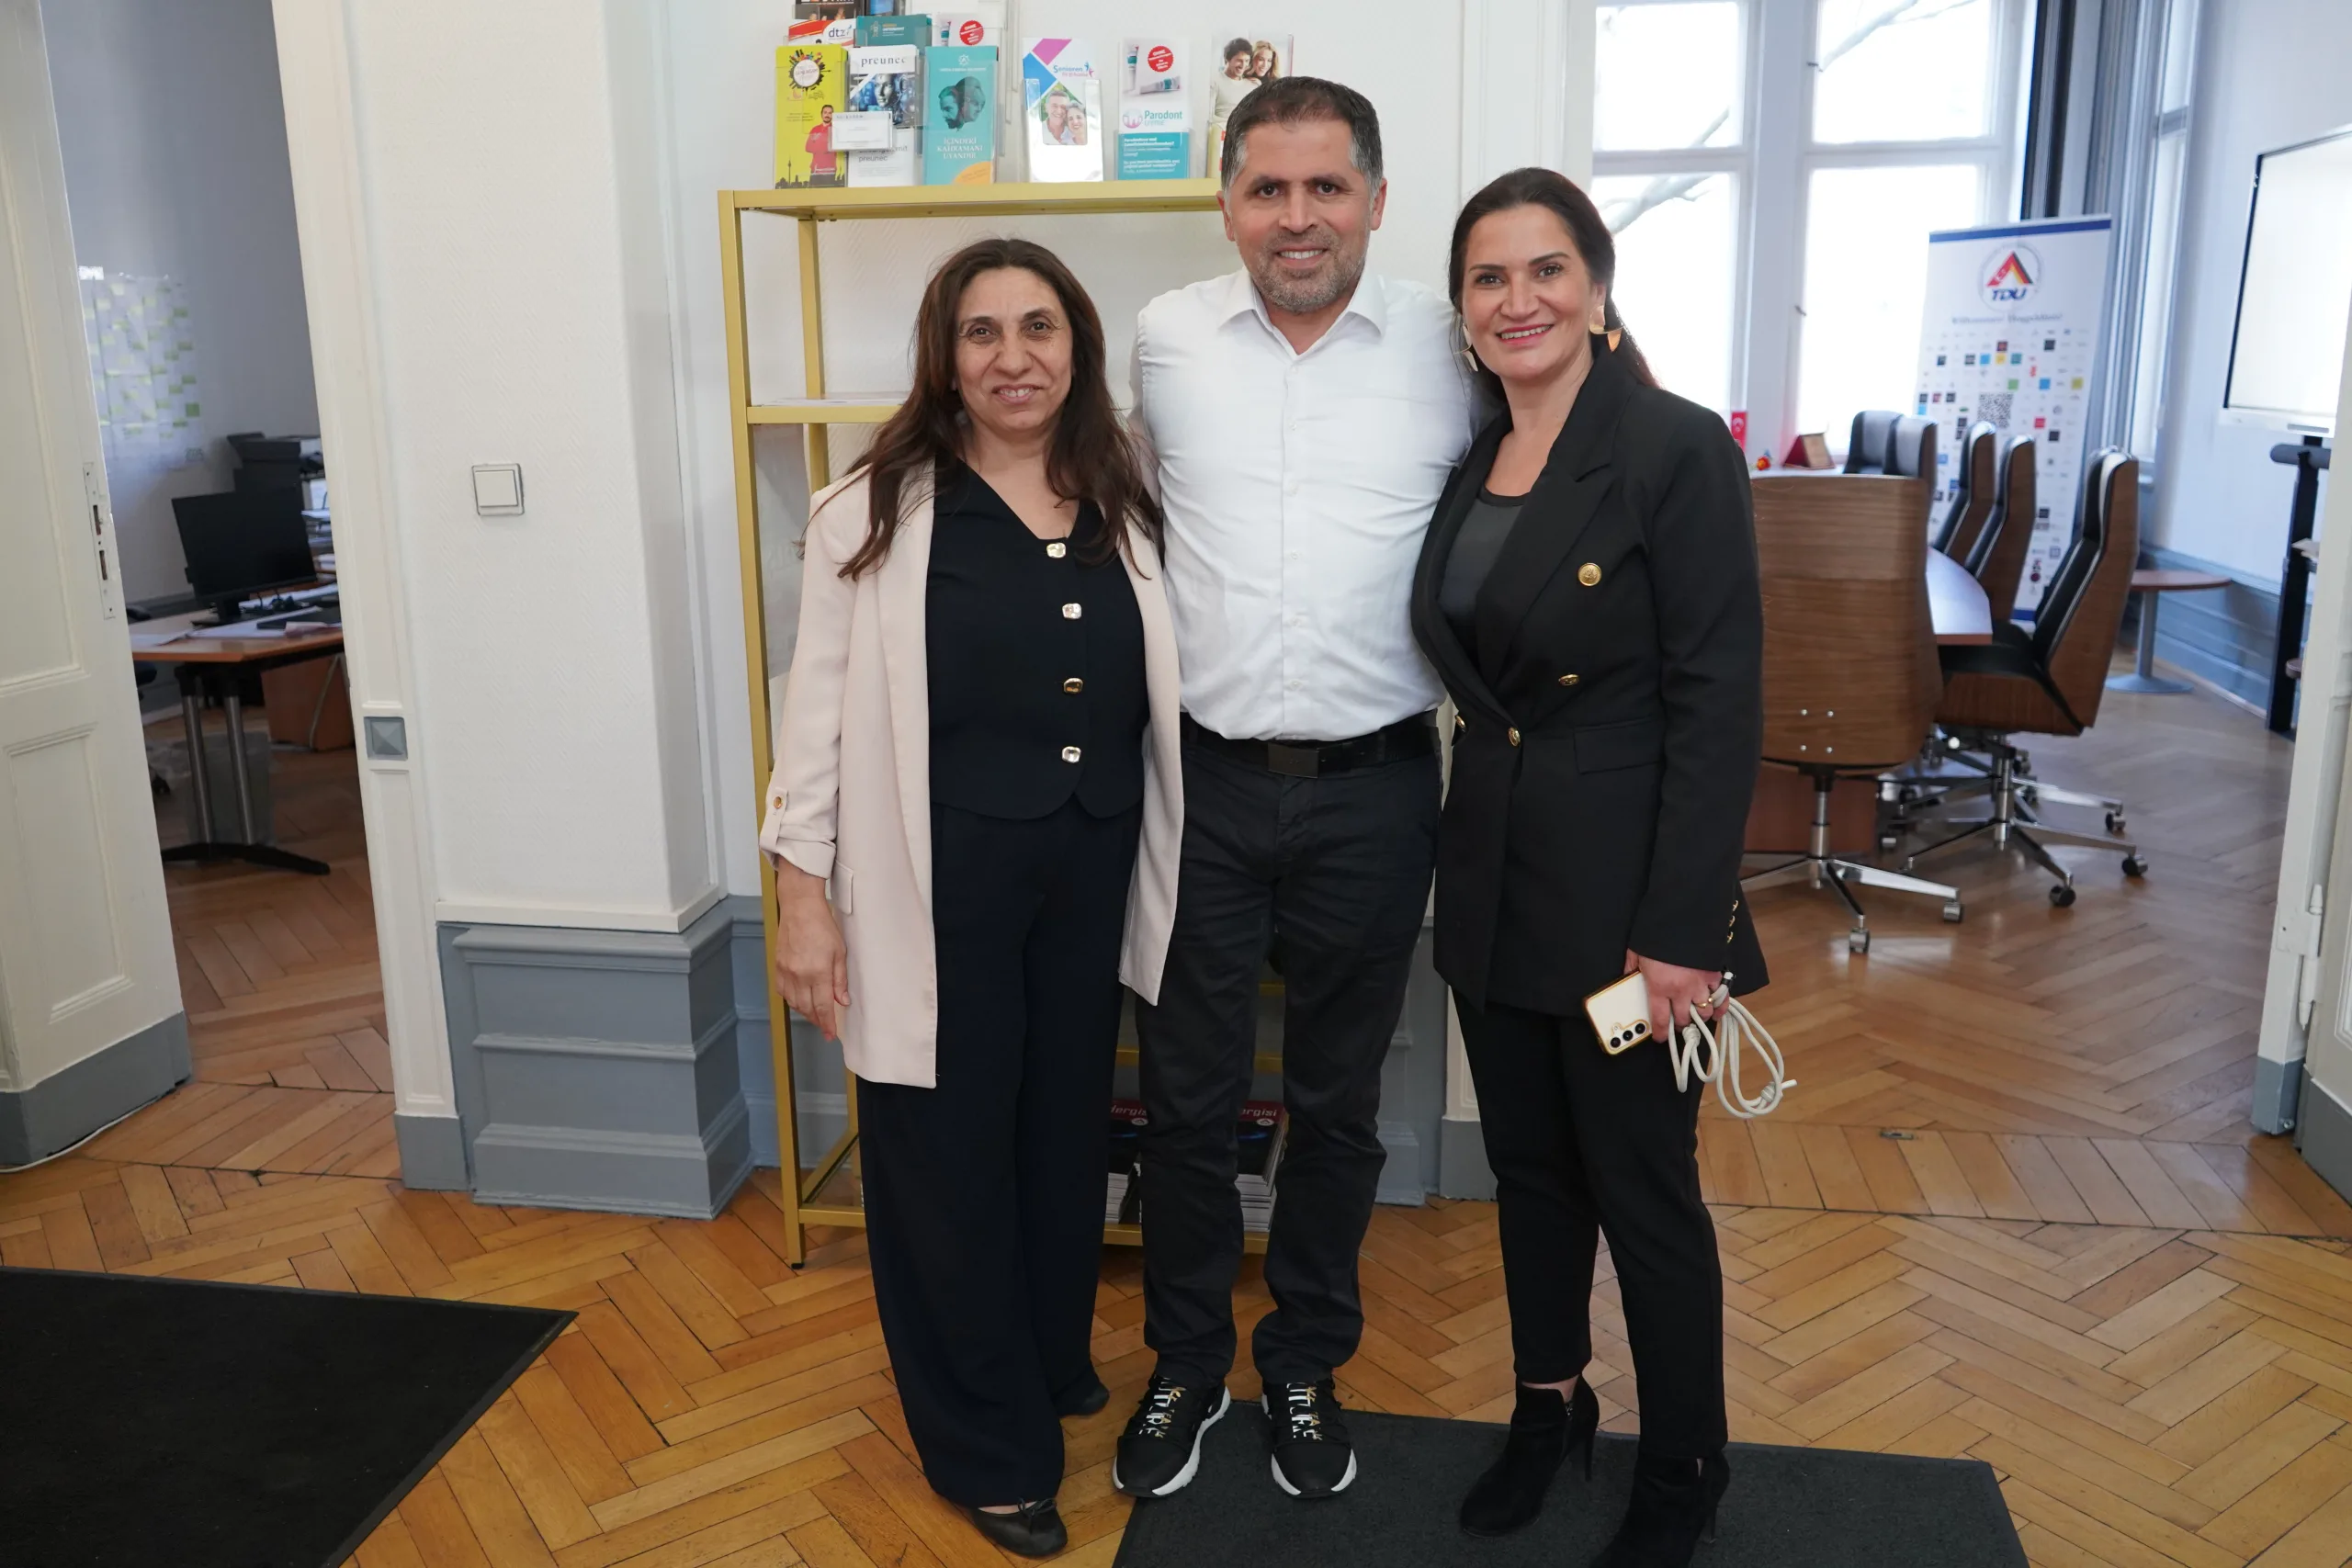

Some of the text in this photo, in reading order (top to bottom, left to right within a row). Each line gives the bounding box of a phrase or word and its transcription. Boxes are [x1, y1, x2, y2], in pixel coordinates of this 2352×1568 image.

[1144, 109, 1183, 119] Parodont
[1991, 287, 2029, 301] TDU
[1111, 1104, 1147, 1117] ergis
